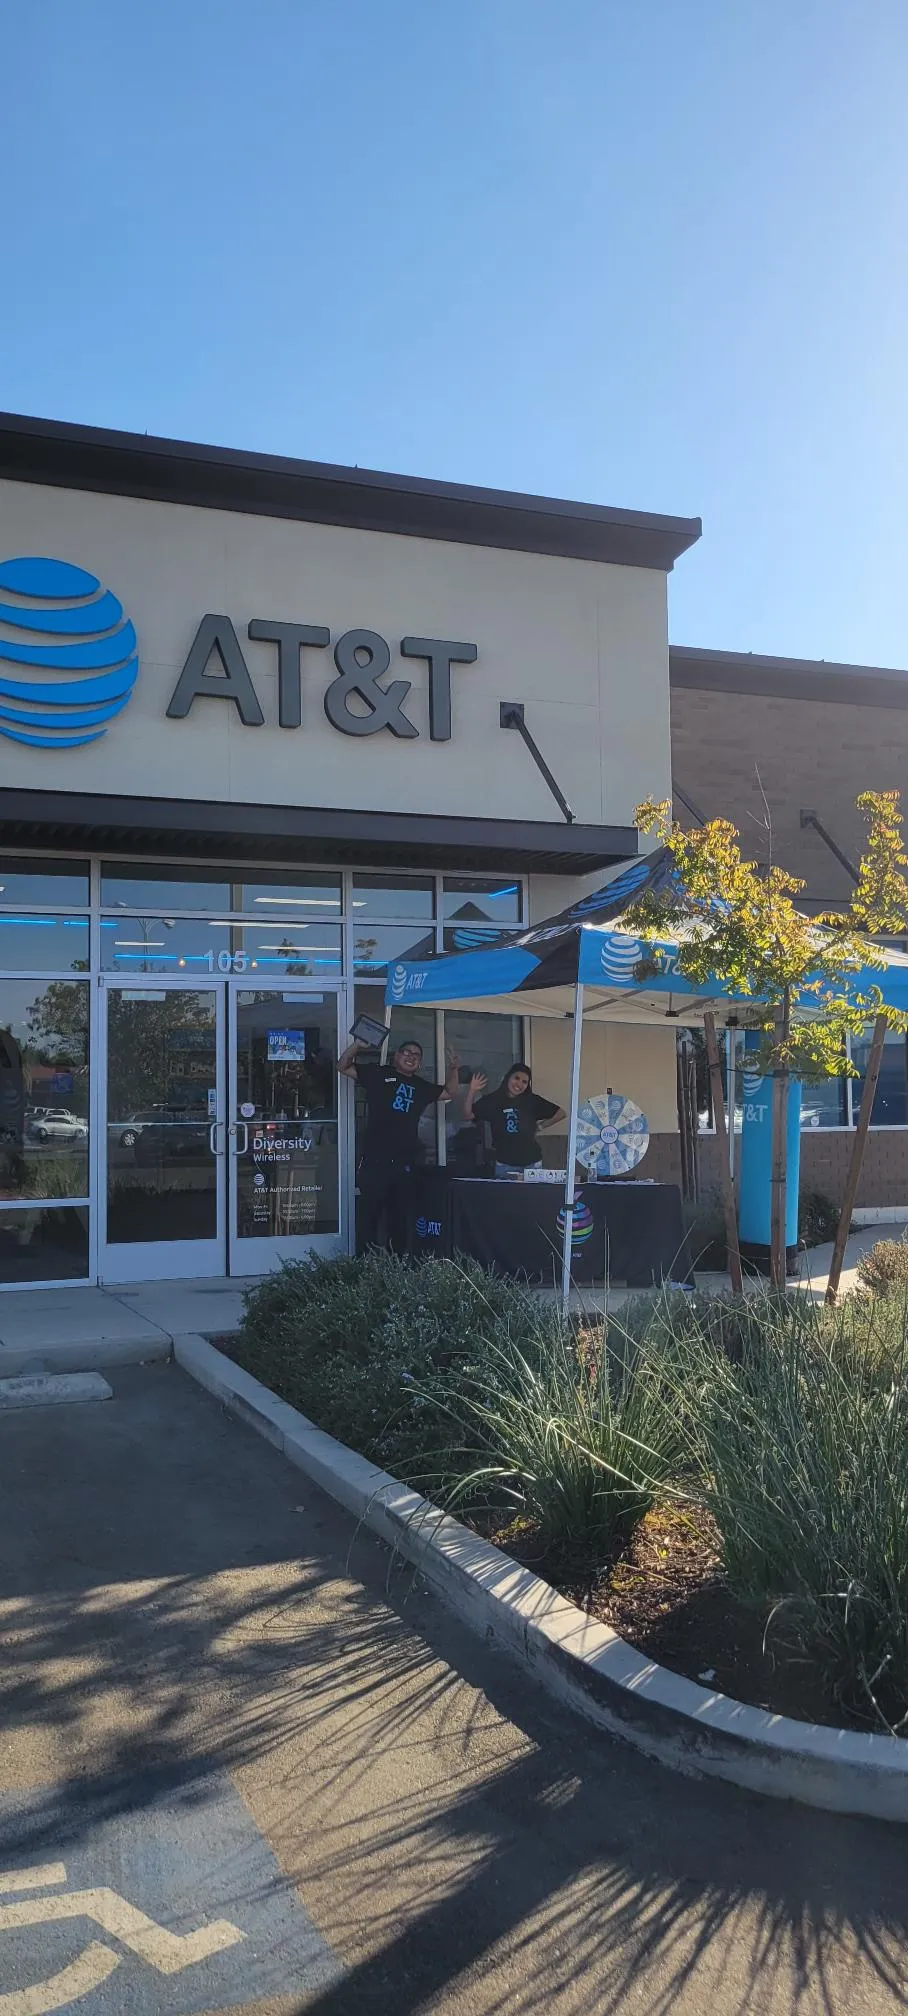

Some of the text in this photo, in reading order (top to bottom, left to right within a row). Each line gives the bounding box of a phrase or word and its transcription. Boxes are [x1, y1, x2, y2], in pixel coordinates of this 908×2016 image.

[165, 613, 478, 742] AT&T
[203, 949, 247, 972] 105
[405, 972, 428, 990] AT&T
[269, 1035, 287, 1046] OPEN
[253, 1137, 312, 1151] Diversity
[253, 1152, 291, 1162] Wireless
